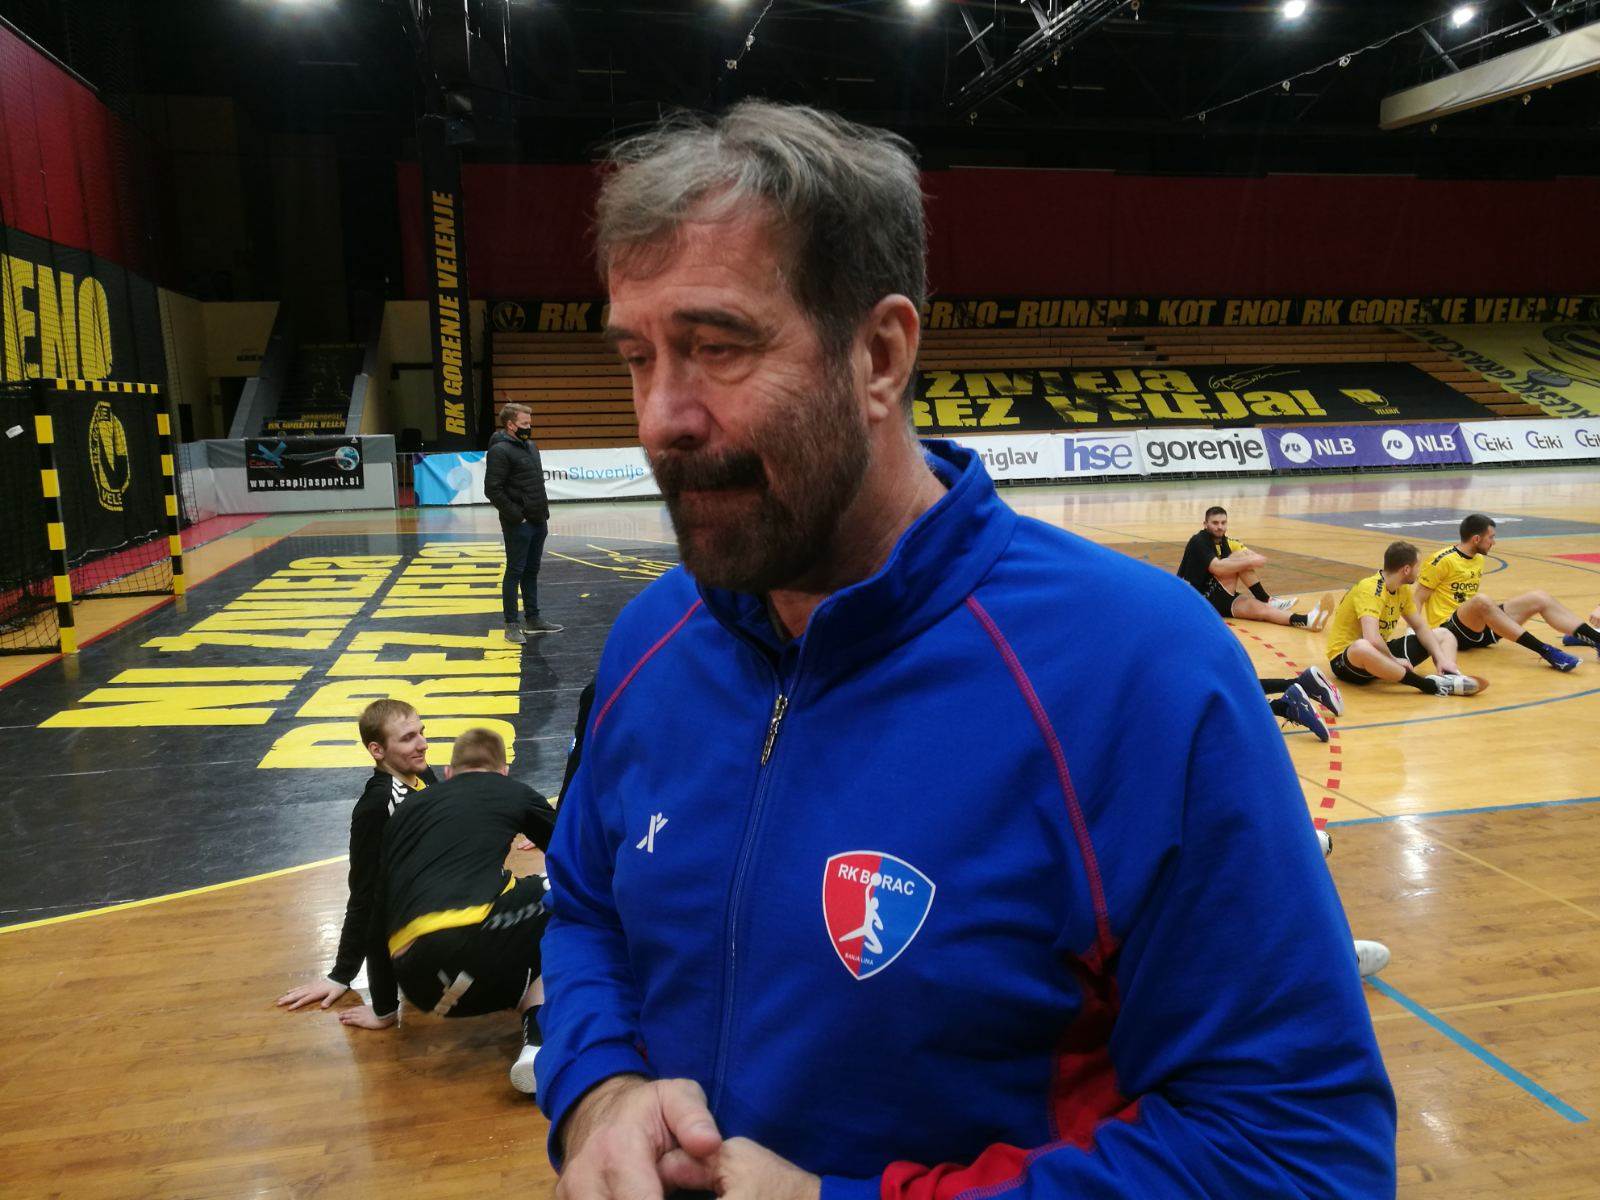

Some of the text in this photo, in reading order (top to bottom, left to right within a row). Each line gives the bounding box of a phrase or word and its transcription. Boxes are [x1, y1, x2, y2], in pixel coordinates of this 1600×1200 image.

[432, 190, 466, 436] RK GORENJE VELENJE
[537, 302, 593, 331] RK
[1158, 300, 1216, 326] KOT
[1223, 299, 1291, 326] ENO!
[1302, 299, 1344, 325] RK
[1064, 436, 1132, 471] hse
[1147, 433, 1264, 467] gorenje
[1313, 438, 1356, 456] NLB
[1415, 435, 1456, 453] NLB
[838, 863, 915, 896] RK BORAC
